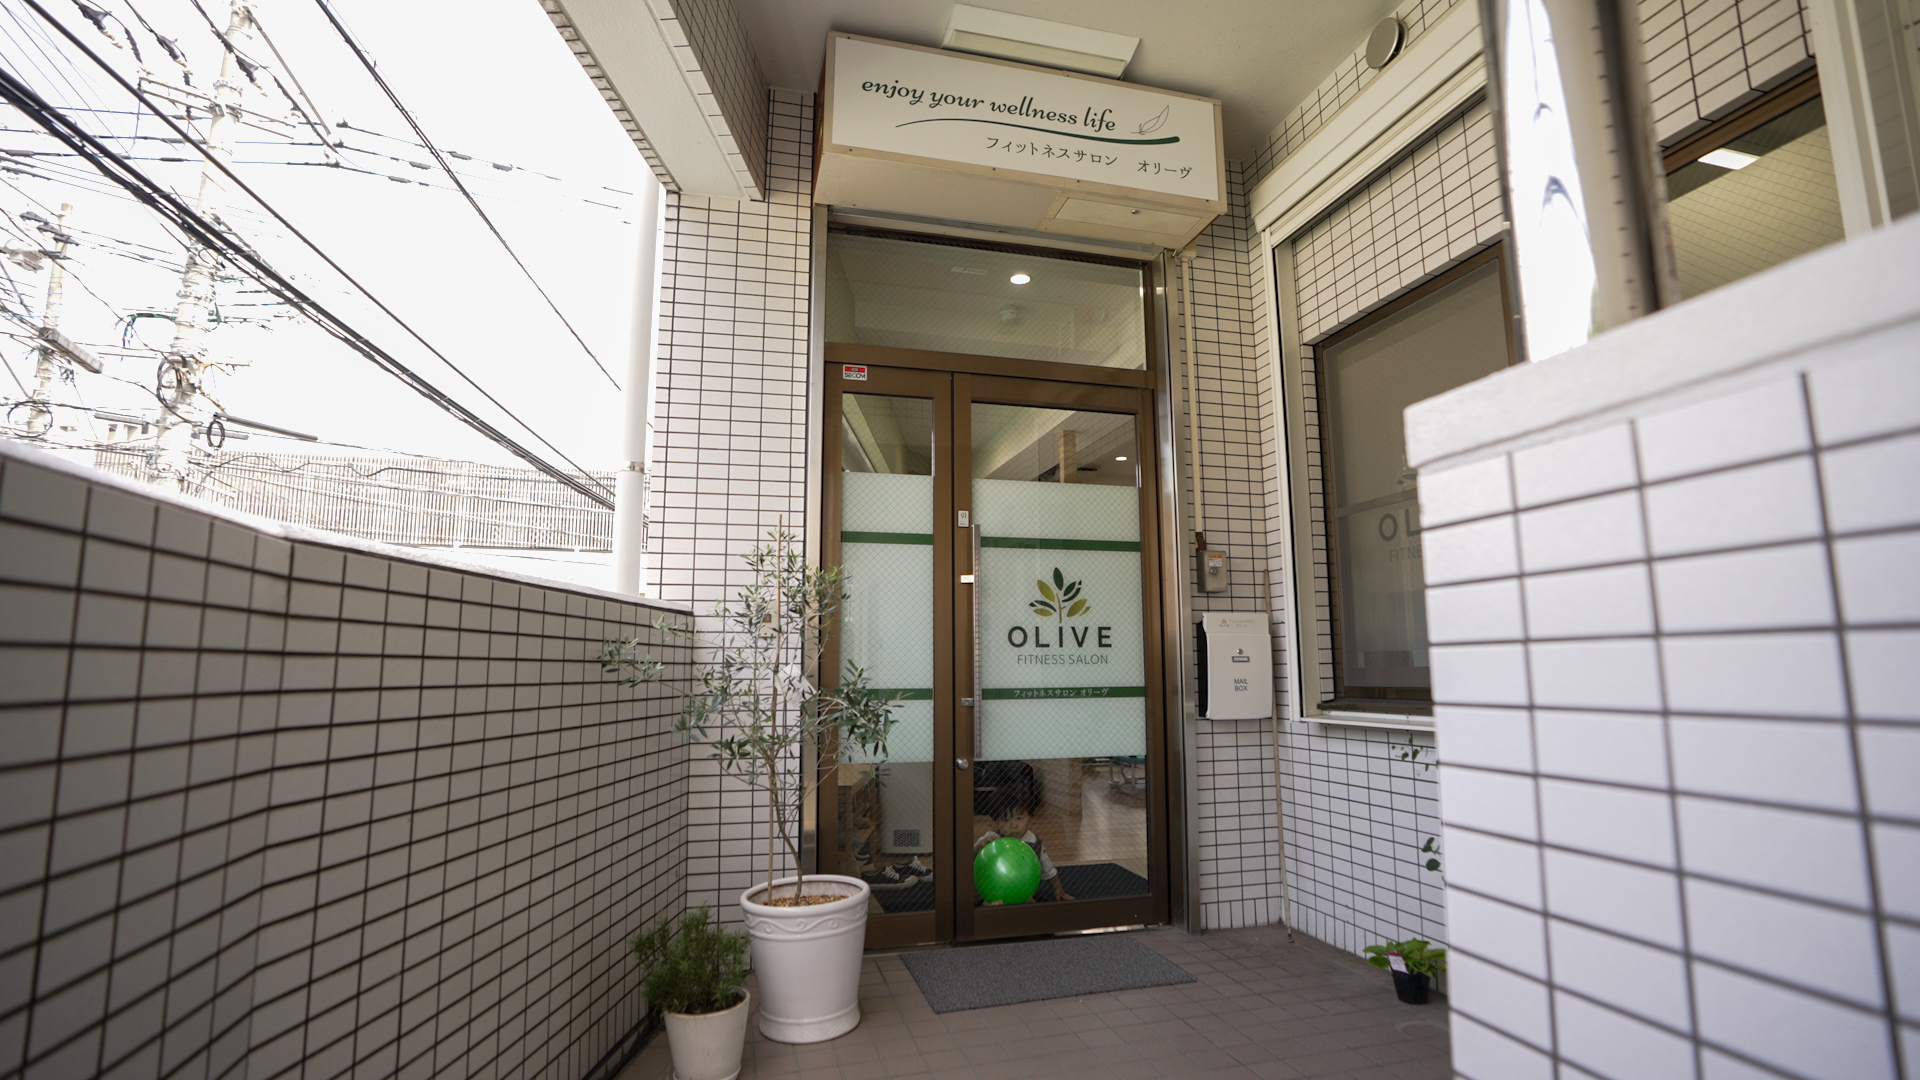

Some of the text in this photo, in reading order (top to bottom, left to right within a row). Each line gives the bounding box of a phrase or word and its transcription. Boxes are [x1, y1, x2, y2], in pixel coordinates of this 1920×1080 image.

[861, 79, 1116, 132] enjoy your wellness life
[986, 136, 1193, 178] フィットネスサロン オリーヴ
[1389, 544, 1423, 562] FITNE
[1008, 626, 1112, 648] OLIVE
[1017, 654, 1108, 665] FITNESS SALON
[1080, 688, 1109, 696] オリーヴ
